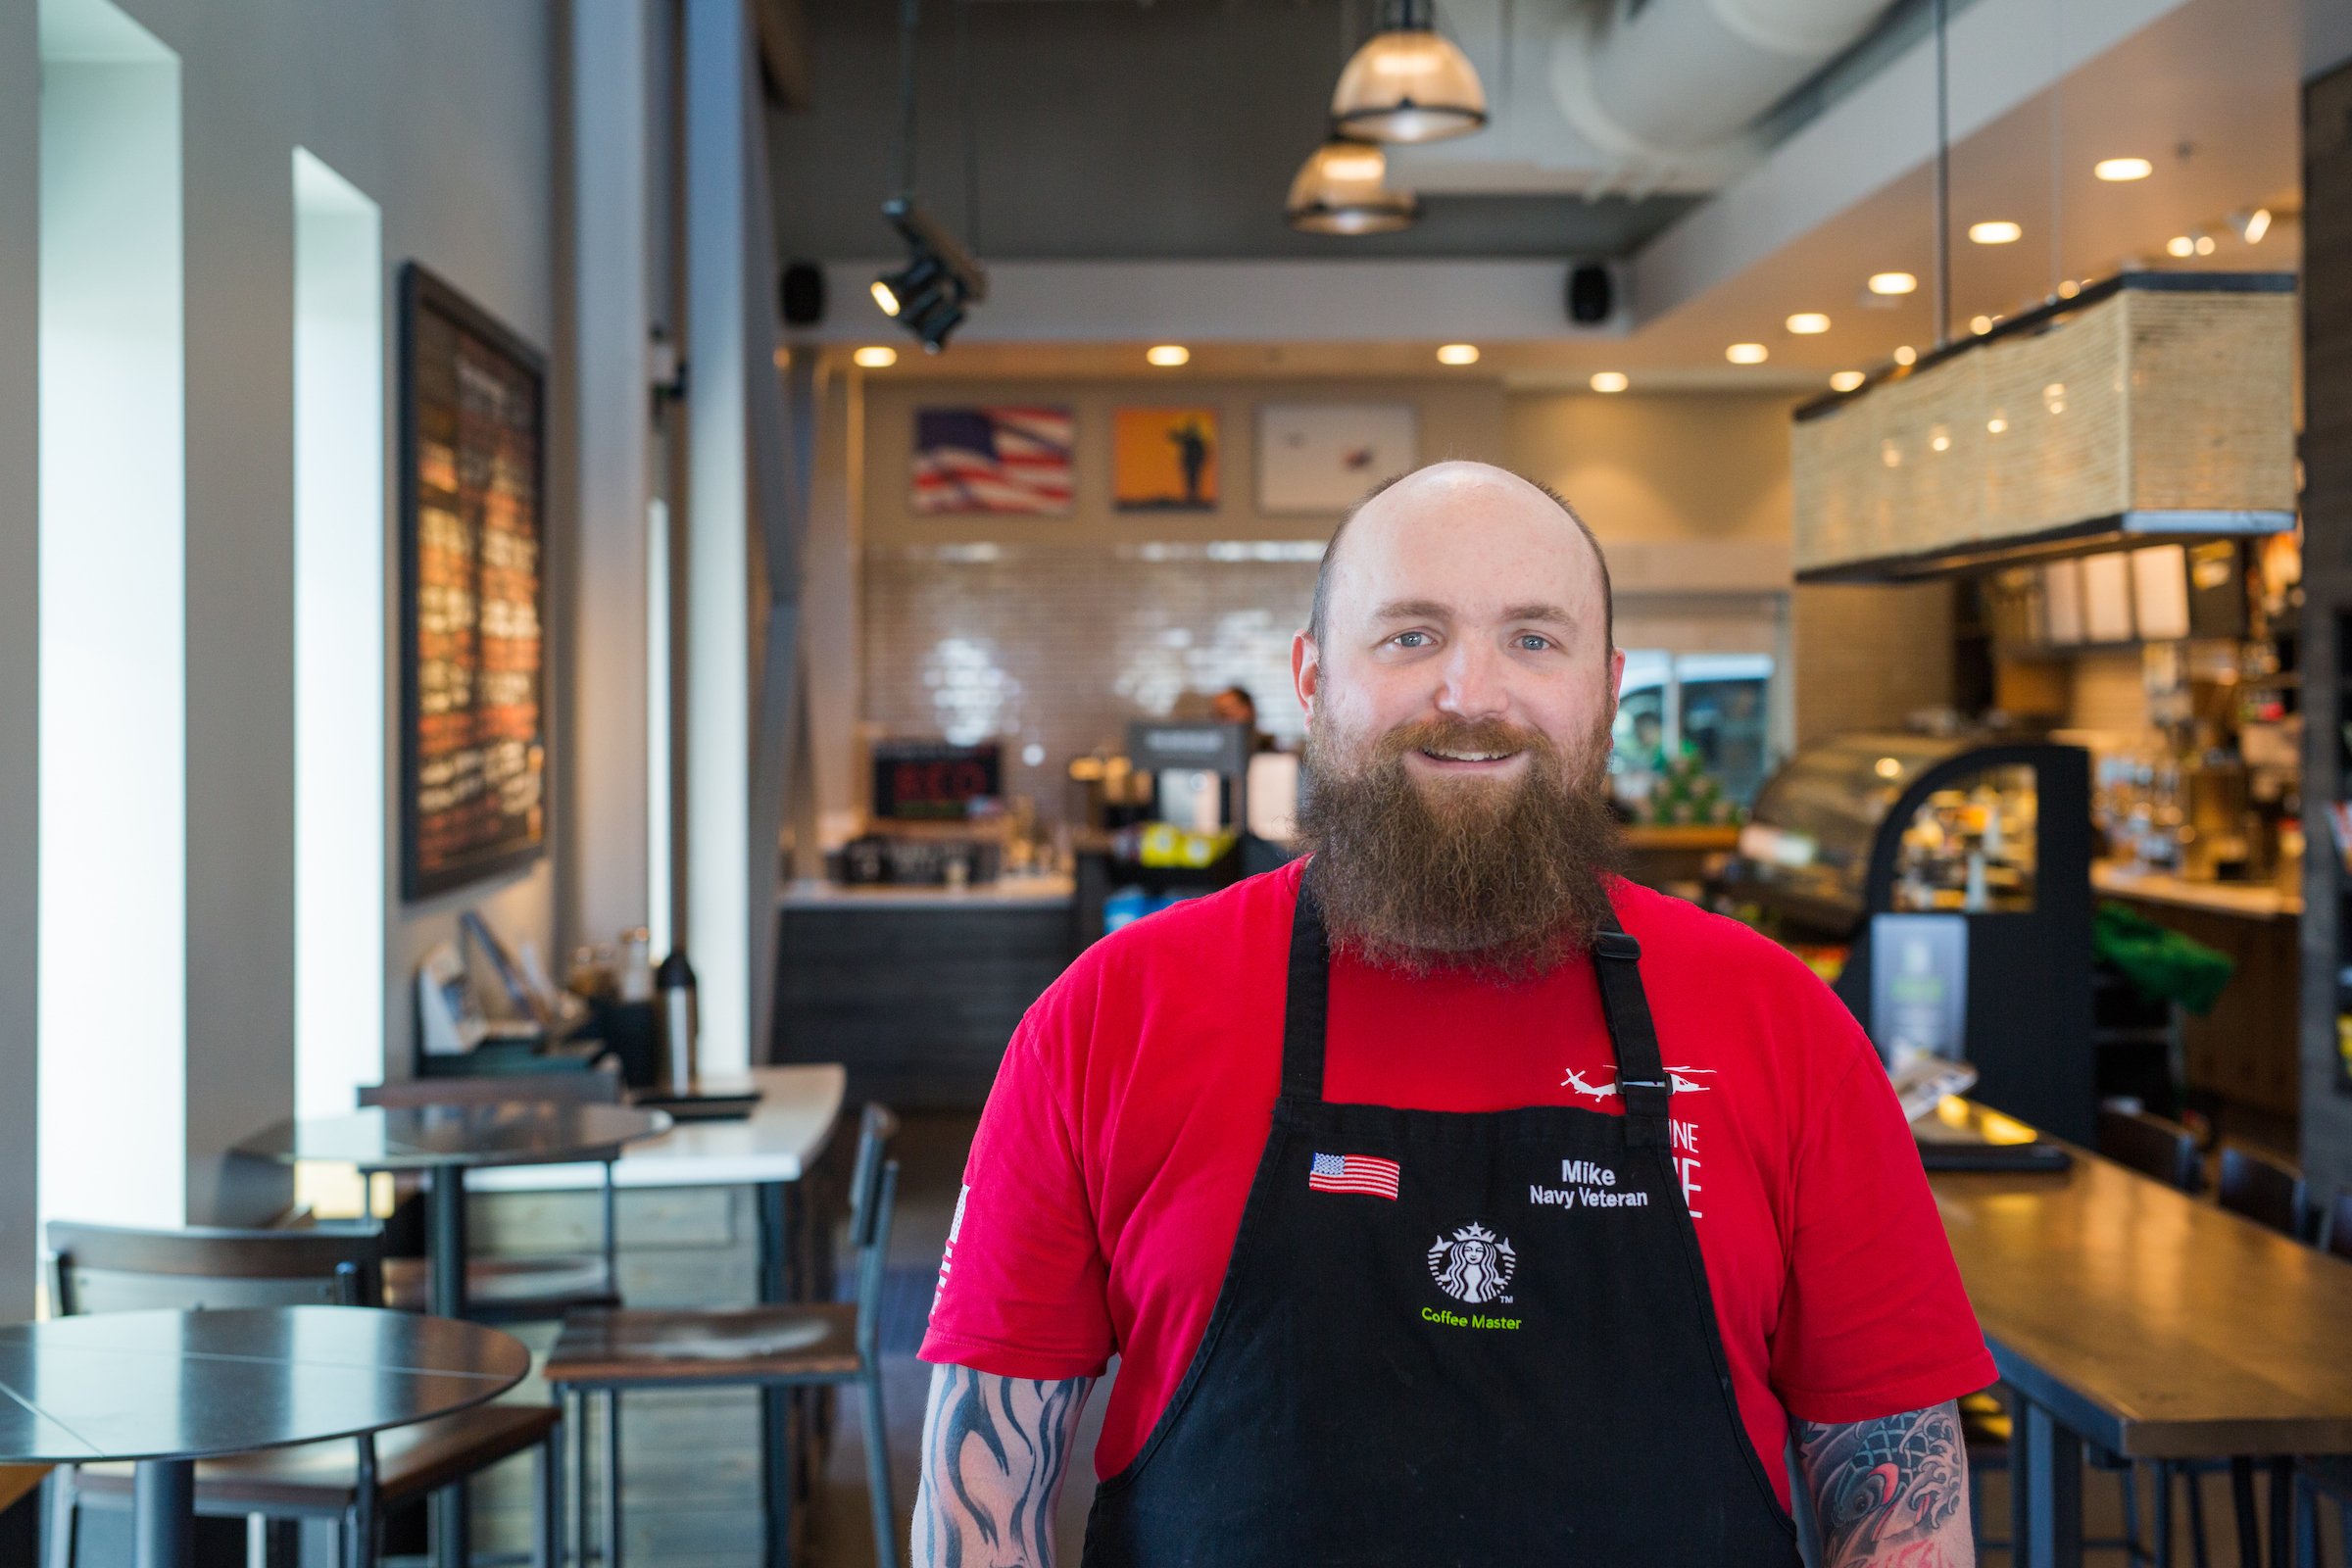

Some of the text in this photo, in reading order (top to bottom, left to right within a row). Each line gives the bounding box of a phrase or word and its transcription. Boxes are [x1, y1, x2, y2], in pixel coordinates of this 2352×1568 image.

[1562, 1159, 1616, 1187] Mike
[1530, 1185, 1648, 1210] Navy Veteran
[1499, 1295, 1514, 1304] TM
[1421, 1306, 1522, 1330] Coffee Master
